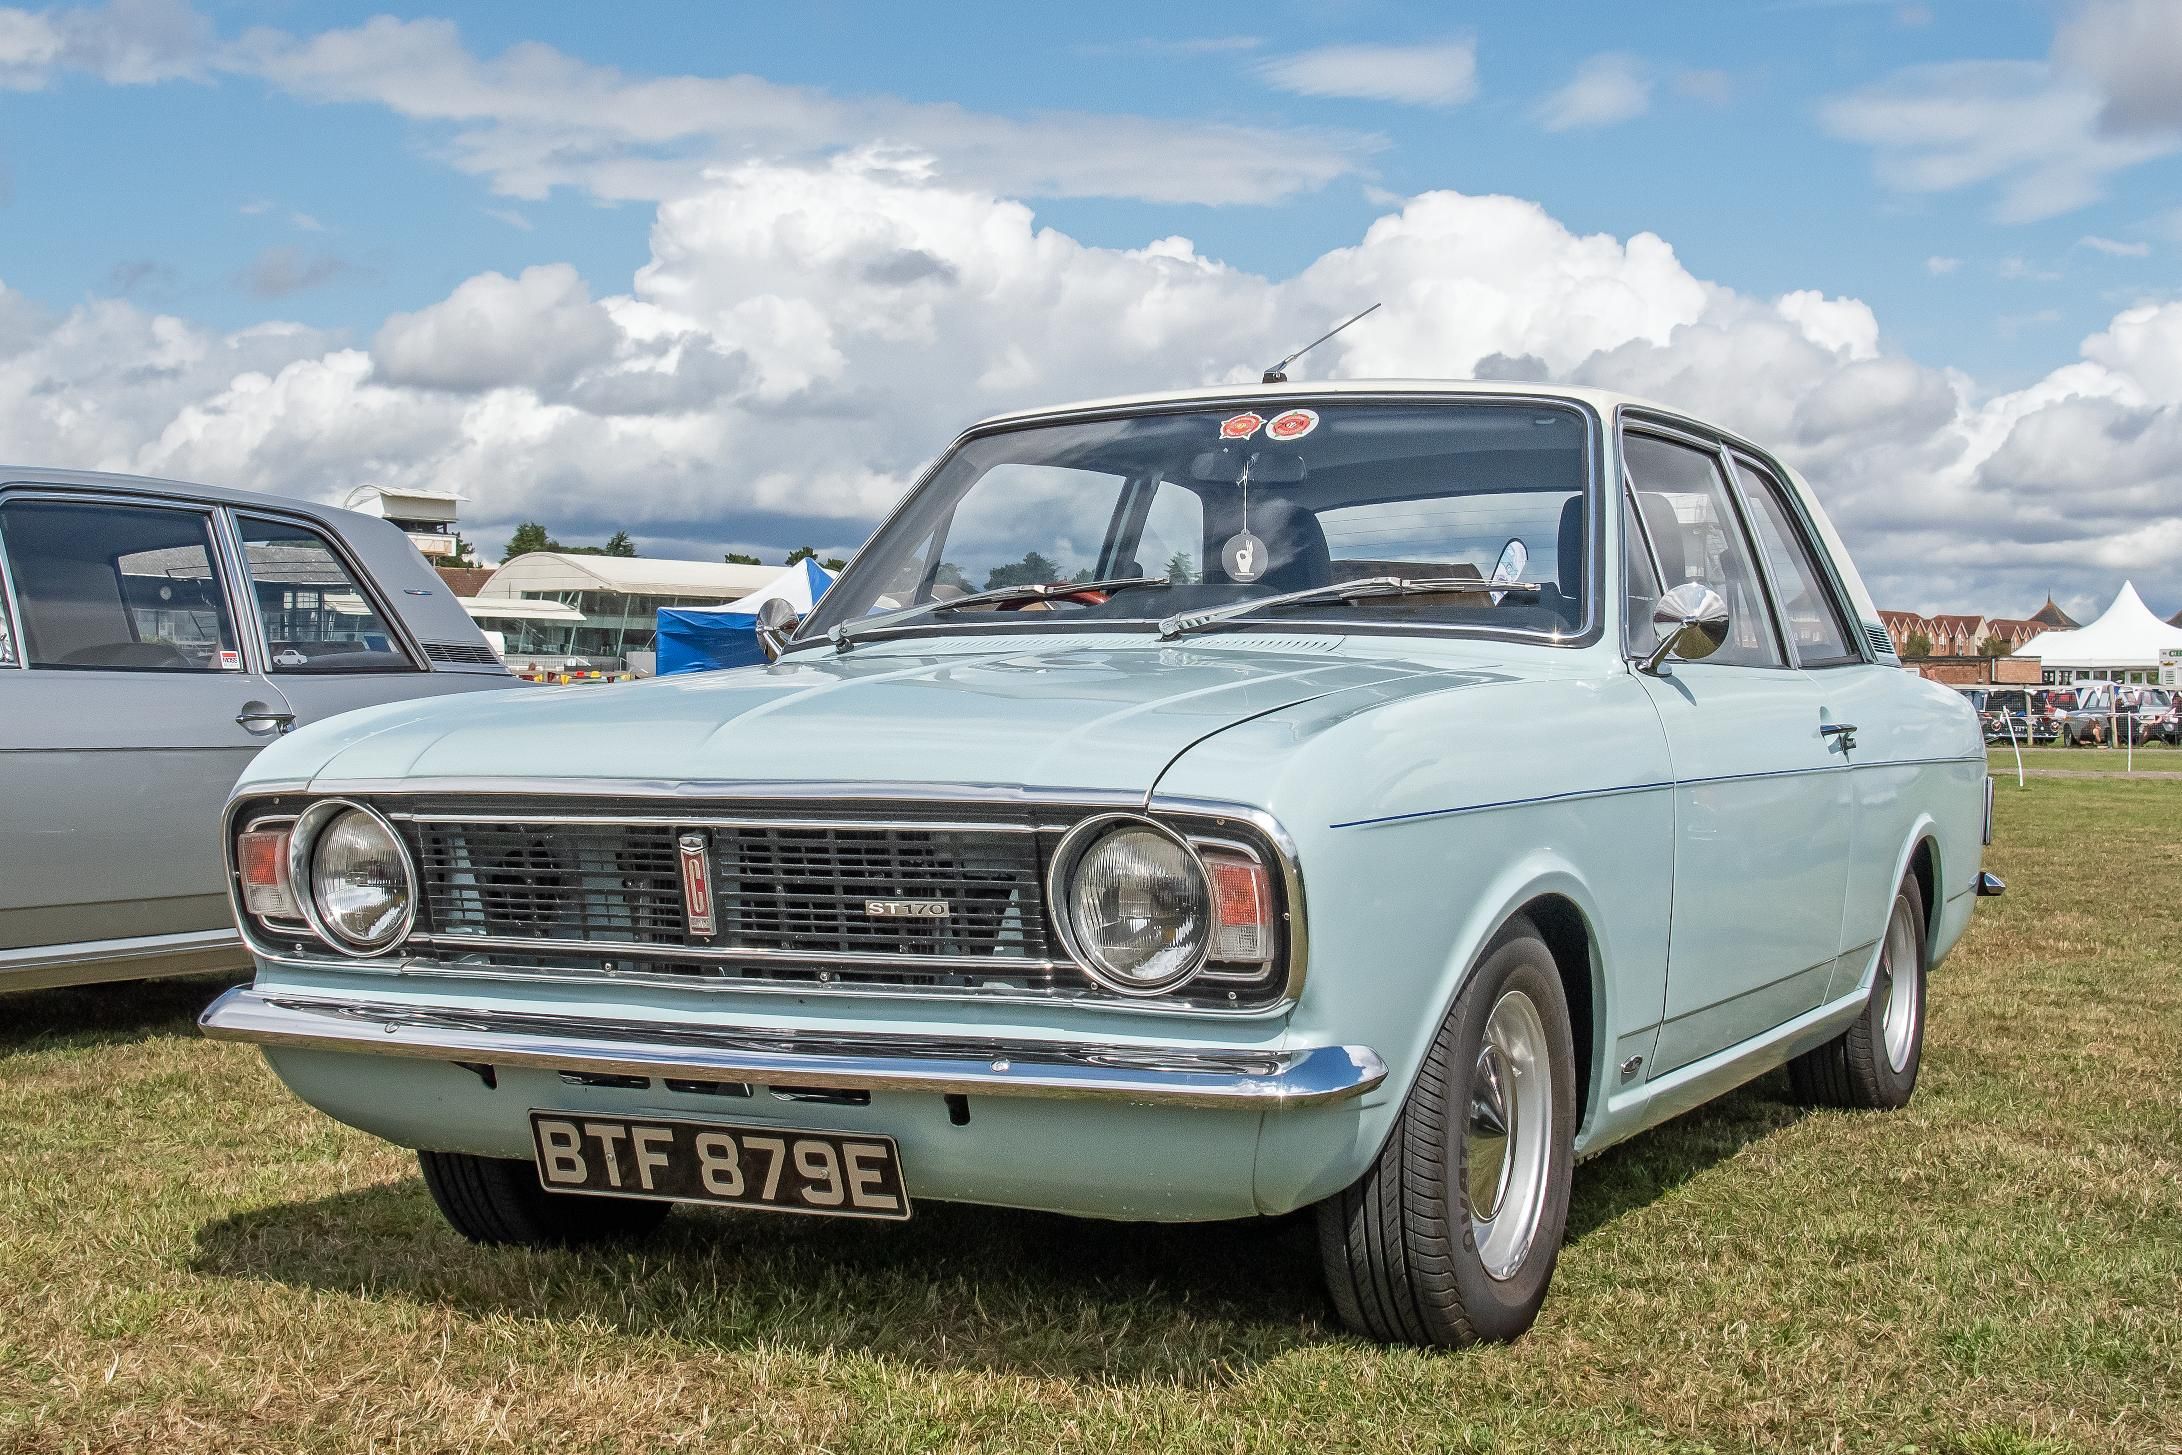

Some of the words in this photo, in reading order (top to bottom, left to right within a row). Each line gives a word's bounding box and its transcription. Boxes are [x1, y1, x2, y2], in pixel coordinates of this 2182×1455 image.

[868, 902, 945, 915] ST170
[537, 1119, 674, 1190] BTF
[696, 1132, 899, 1209] 879E
